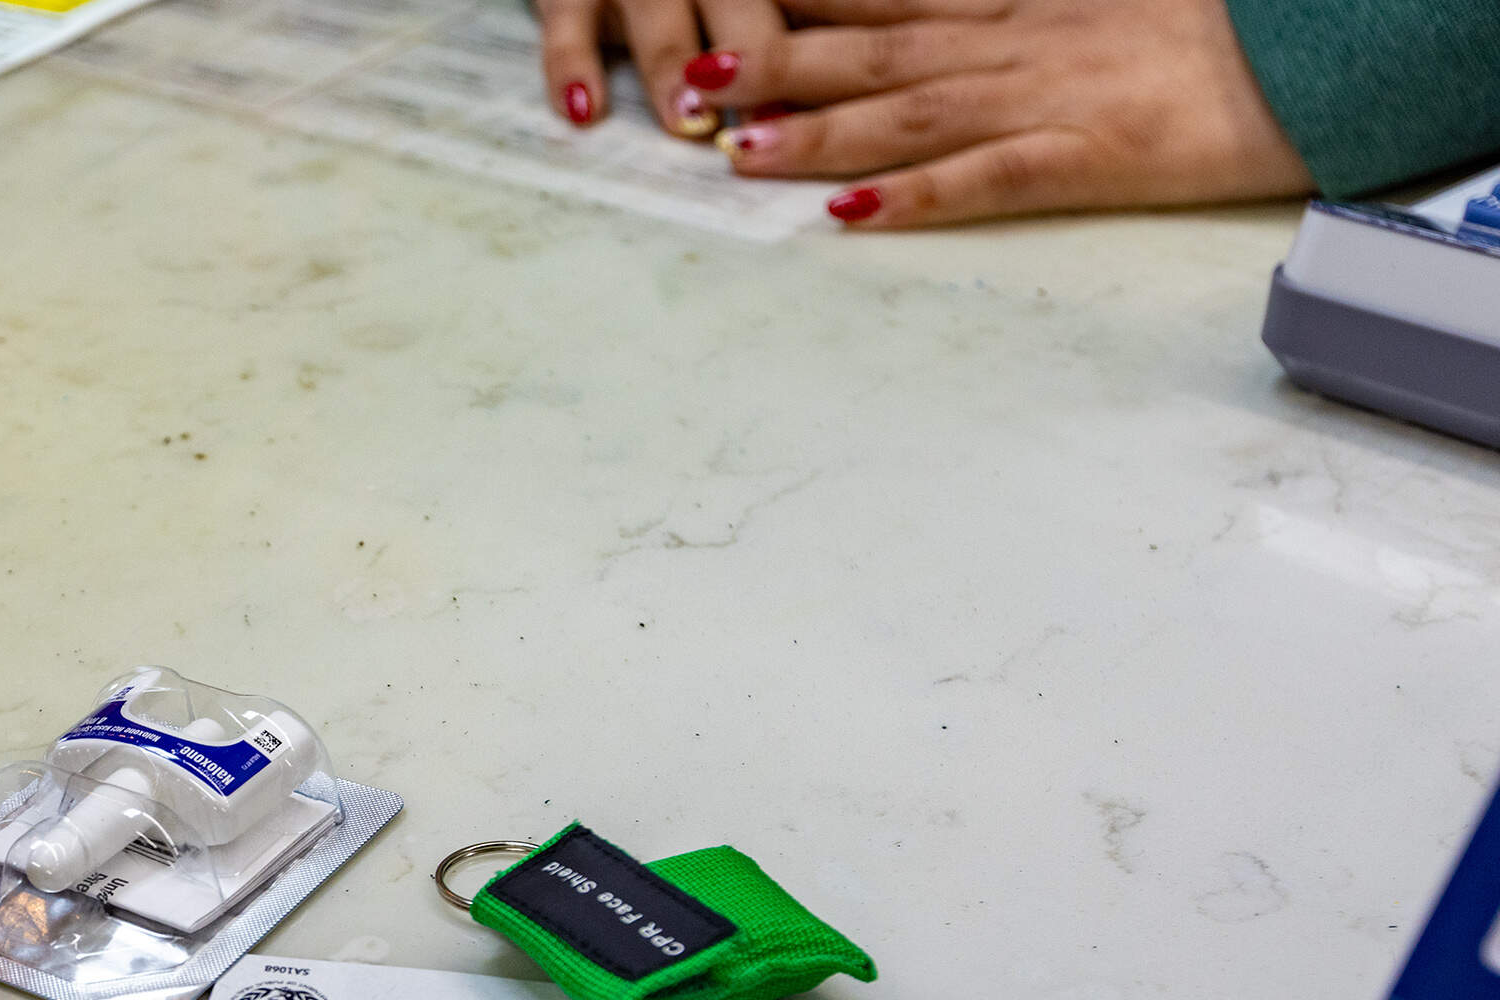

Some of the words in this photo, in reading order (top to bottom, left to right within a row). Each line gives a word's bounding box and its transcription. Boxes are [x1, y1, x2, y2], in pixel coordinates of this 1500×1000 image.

[124, 727, 161, 743] Naloxone
[178, 745, 235, 786] Naloxone
[541, 860, 598, 895] Shield
[597, 890, 644, 926] Face
[639, 919, 687, 957] CPR
[264, 965, 311, 976] SA1068
